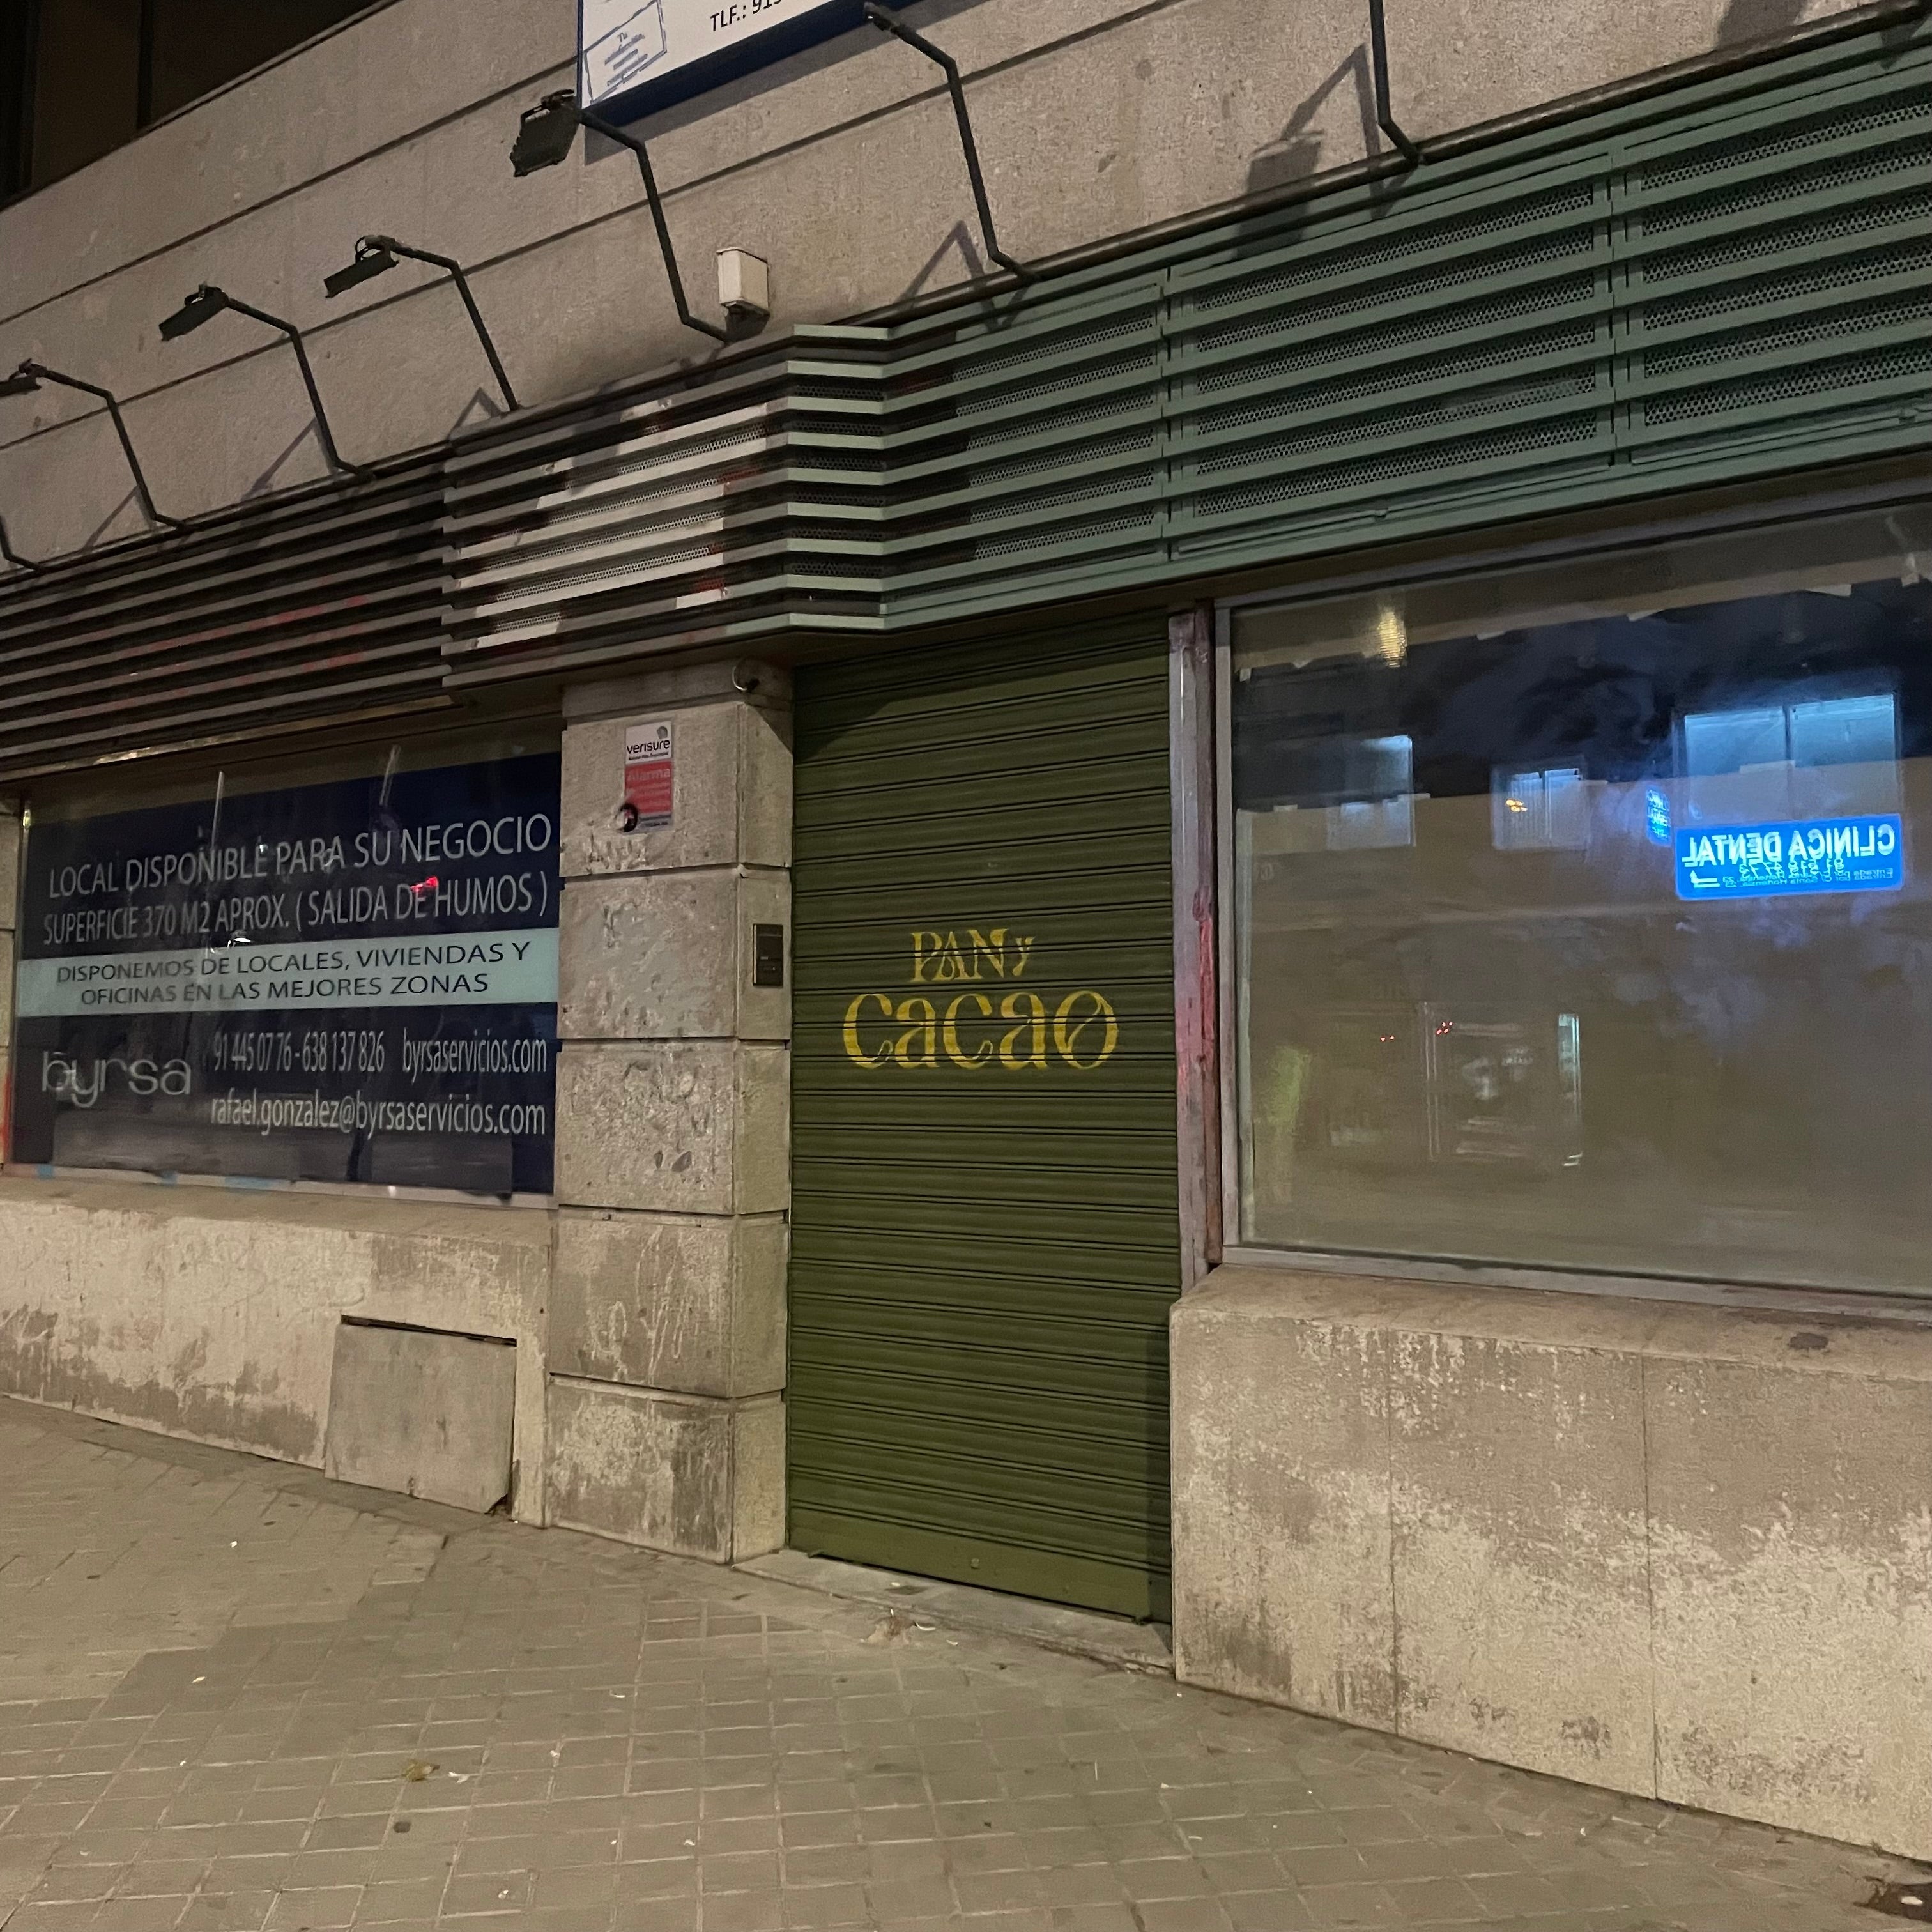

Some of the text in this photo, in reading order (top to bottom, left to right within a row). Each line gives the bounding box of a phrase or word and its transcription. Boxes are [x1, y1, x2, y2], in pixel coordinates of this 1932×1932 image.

[710, 4, 746, 31] TLF.:
[626, 739, 671, 755] verisure
[49, 813, 551, 898] LOCAL DISPONIBLE PARA SU NEGOCIO
[43, 907, 139, 945] SUPERFICIE
[142, 904, 176, 938] 370
[180, 900, 210, 935] M2
[214, 893, 289, 932] APROX.
[395, 882, 427, 920] DE
[56, 940, 532, 983] DISPONEMOS DE LOCALES, VIVIENDAS Y
[80, 972, 489, 1006] OFICINAS EN LAS MEJORES ZONAS
[214, 1031, 228, 1071] 91
[231, 1032, 255, 1071] 445
[257, 1032, 273, 1071] 07
[276, 1031, 293, 1071] 76
[302, 1030, 328, 1072] 638
[331, 1030, 356, 1072] 137
[358, 1029, 385, 1072] 826
[402, 1027, 548, 1085] byrsaservicios.com
[42, 1050, 192, 1108] byrsa
[210, 1087, 546, 1140] rafael.gonzalez@byrsaservicios.com
